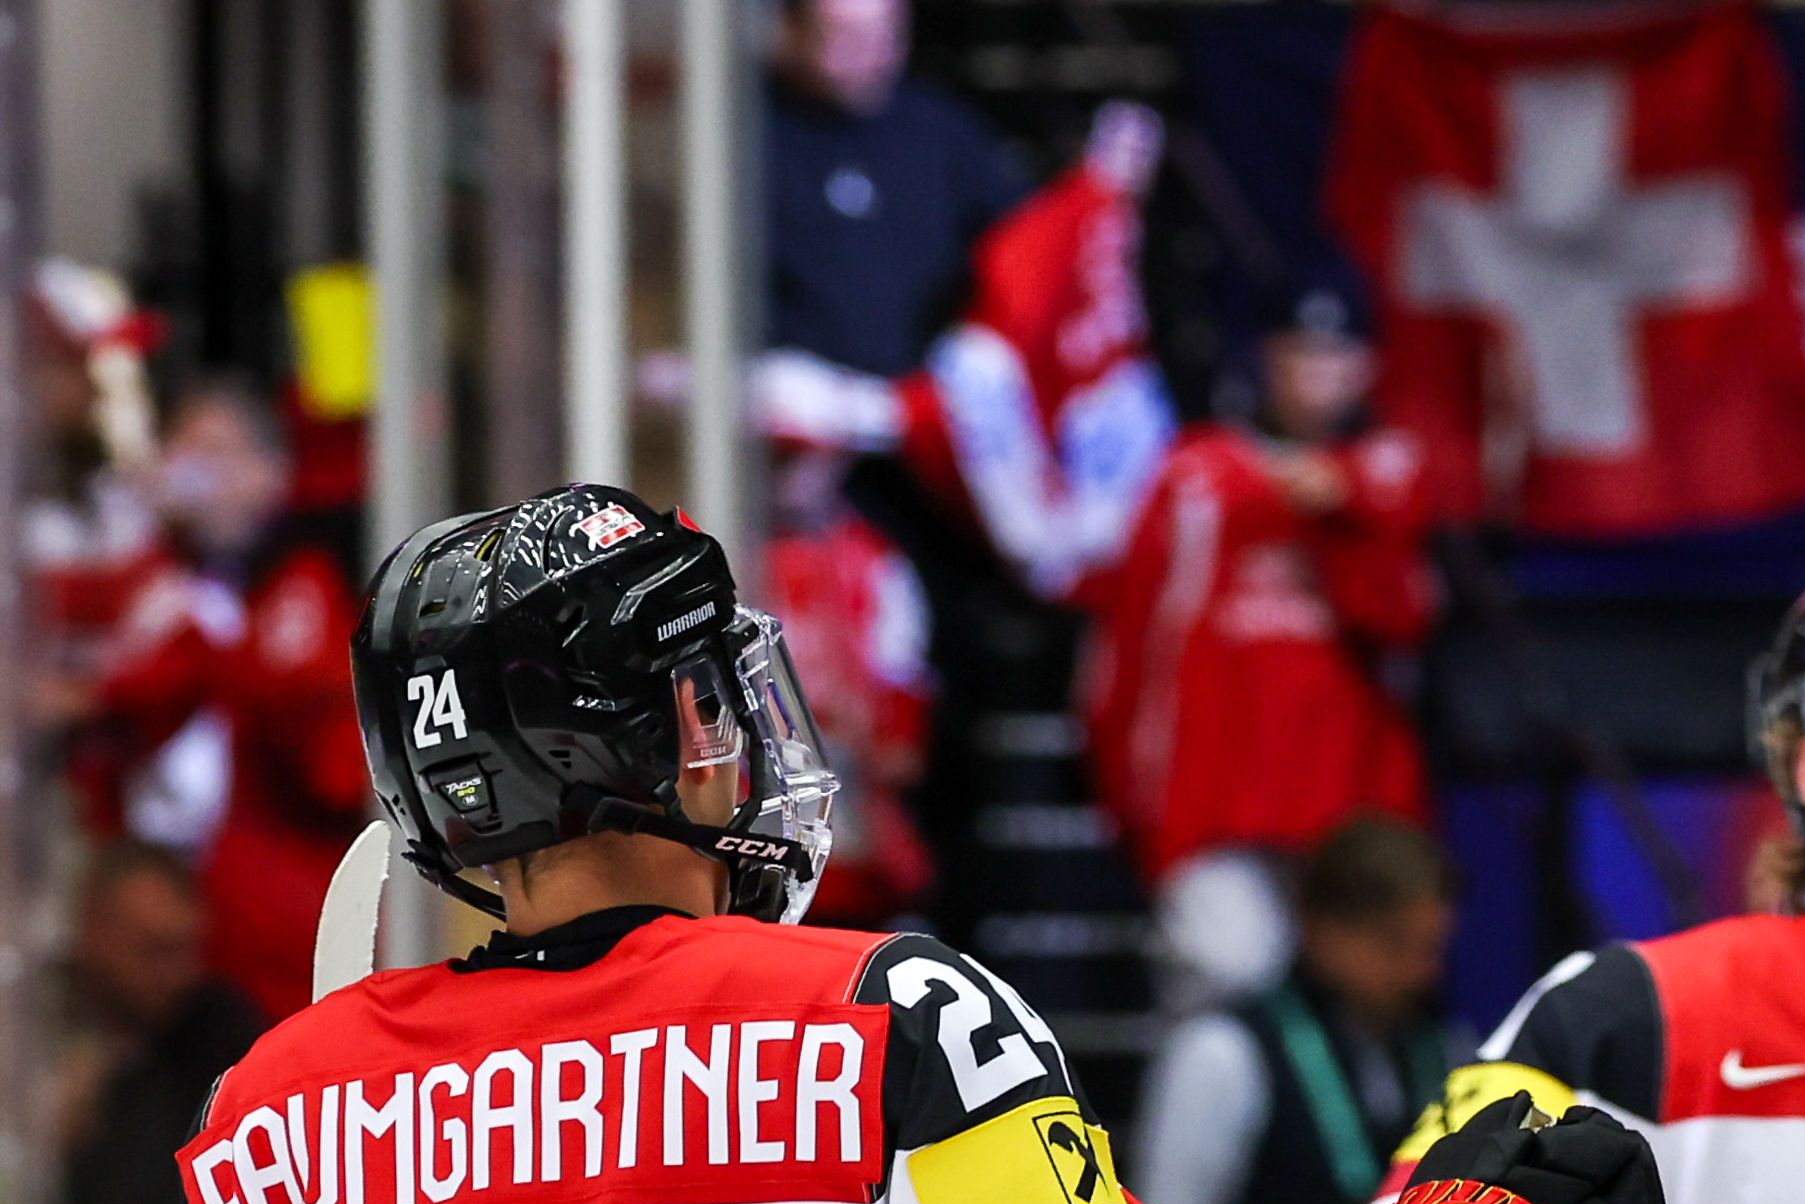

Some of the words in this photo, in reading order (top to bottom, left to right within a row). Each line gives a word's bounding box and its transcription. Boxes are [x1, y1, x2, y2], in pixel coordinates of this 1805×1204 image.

[656, 600, 717, 642] WARRIOR
[407, 667, 467, 749] 24
[714, 835, 789, 860] CCM
